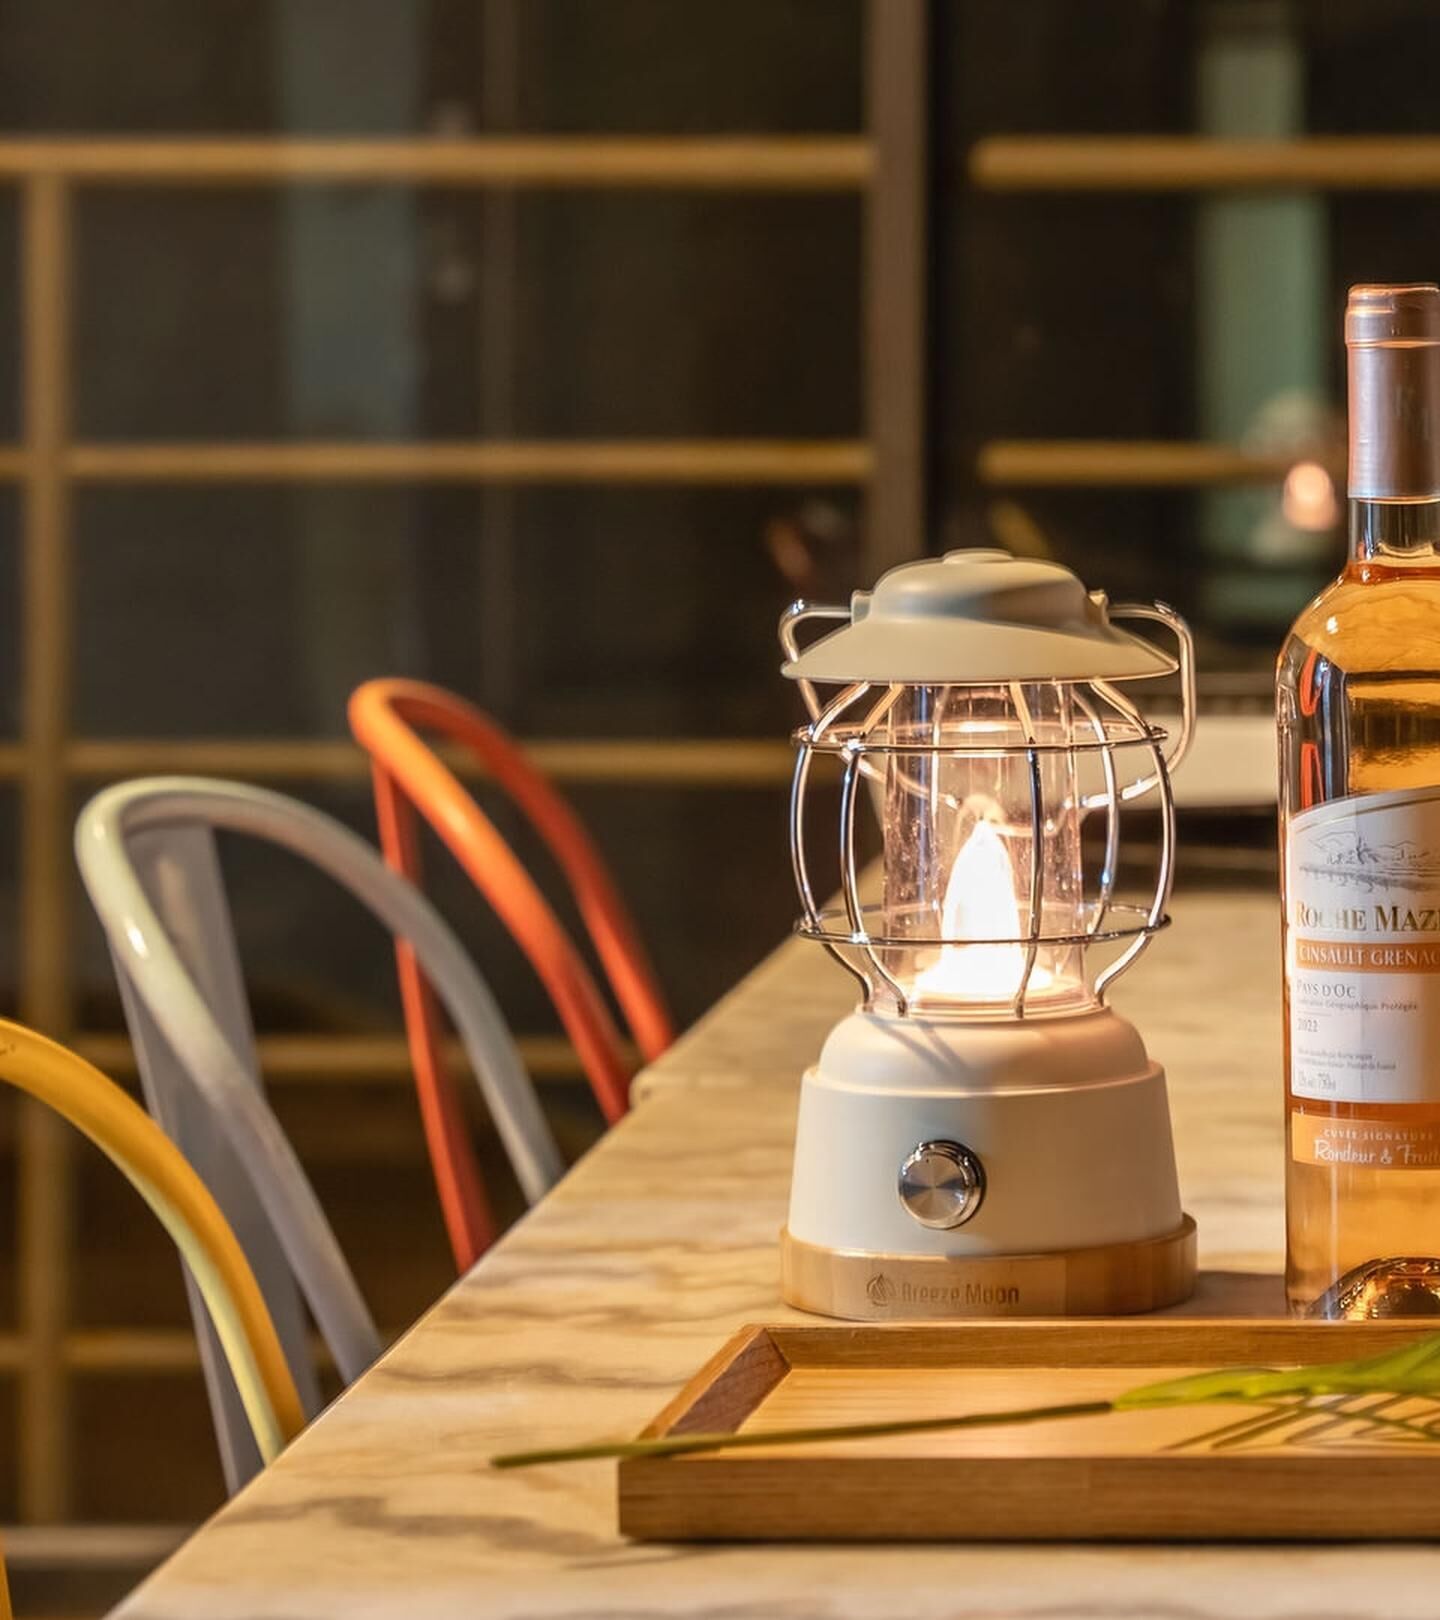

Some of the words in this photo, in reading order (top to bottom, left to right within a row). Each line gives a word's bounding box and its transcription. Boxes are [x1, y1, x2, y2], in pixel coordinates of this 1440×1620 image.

[1296, 901, 1367, 932] ROCHE
[1299, 945, 1366, 967] CINSAULT
[1314, 1139, 1376, 1164] Rondeur
[1380, 1146, 1393, 1165] &
[901, 1282, 960, 1302] Breeze
[965, 1283, 1020, 1305] Moon
